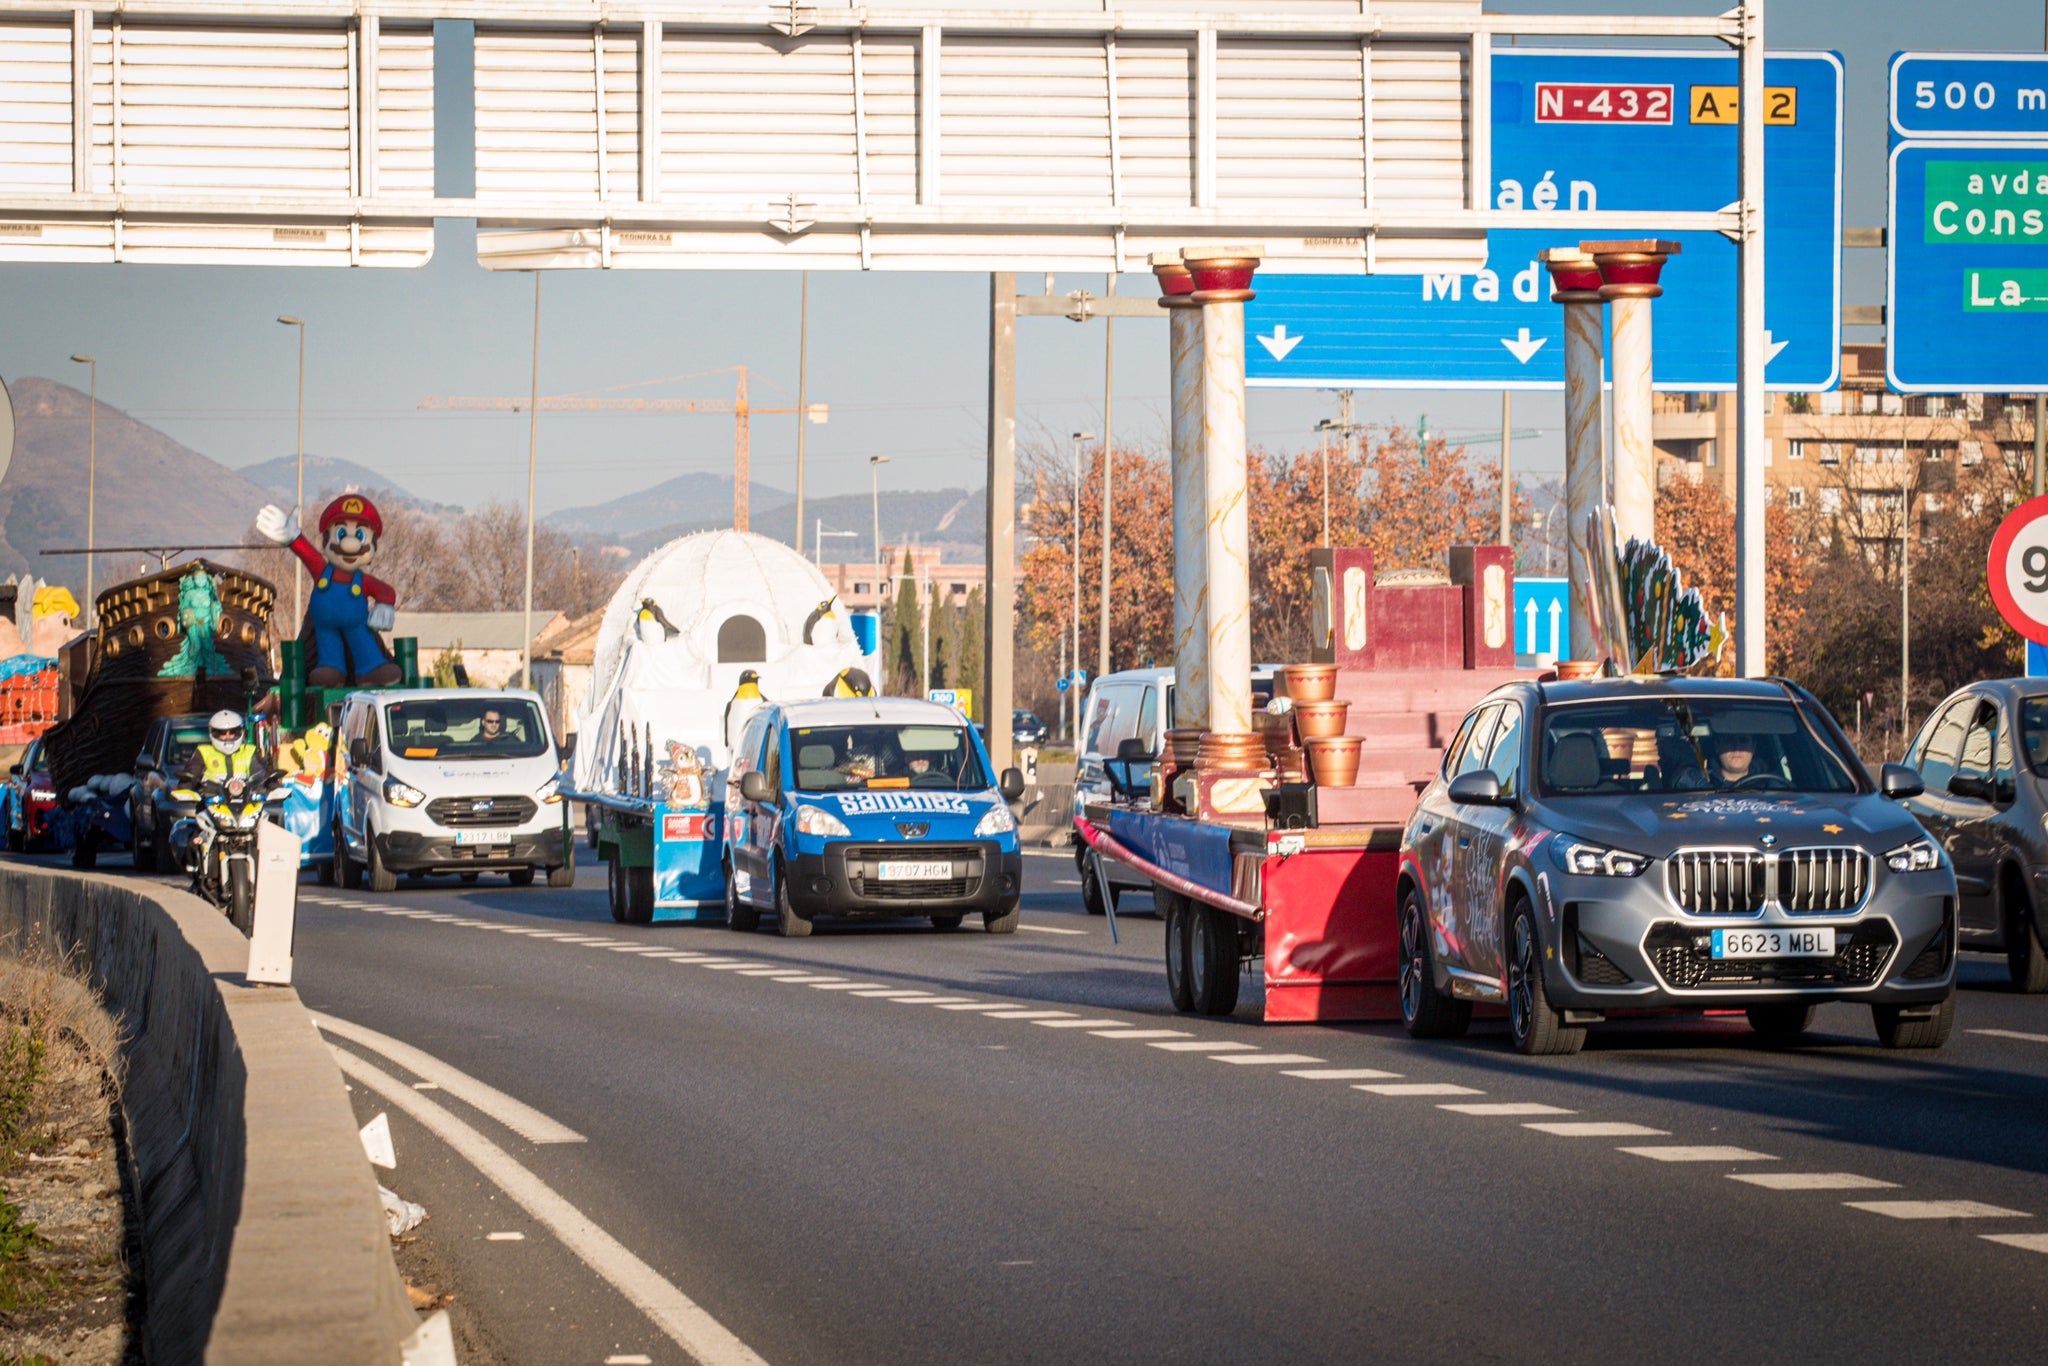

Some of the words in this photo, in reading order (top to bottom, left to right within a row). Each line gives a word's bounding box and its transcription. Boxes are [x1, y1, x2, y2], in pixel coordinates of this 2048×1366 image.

[1540, 89, 1668, 118] N-432
[1697, 92, 1791, 119] A-2
[1915, 80, 1996, 110] 500
[2017, 88, 2047, 110] m
[1967, 169, 2048, 195] avda
[1933, 200, 2044, 235] Cons
[1422, 260, 1557, 302] Mad
[1971, 272, 2022, 306] La
[344, 500, 361, 511] M
[924, 864, 949, 877] HGM
[1727, 934, 1781, 953] 6623
[1789, 933, 1828, 953] MBL
